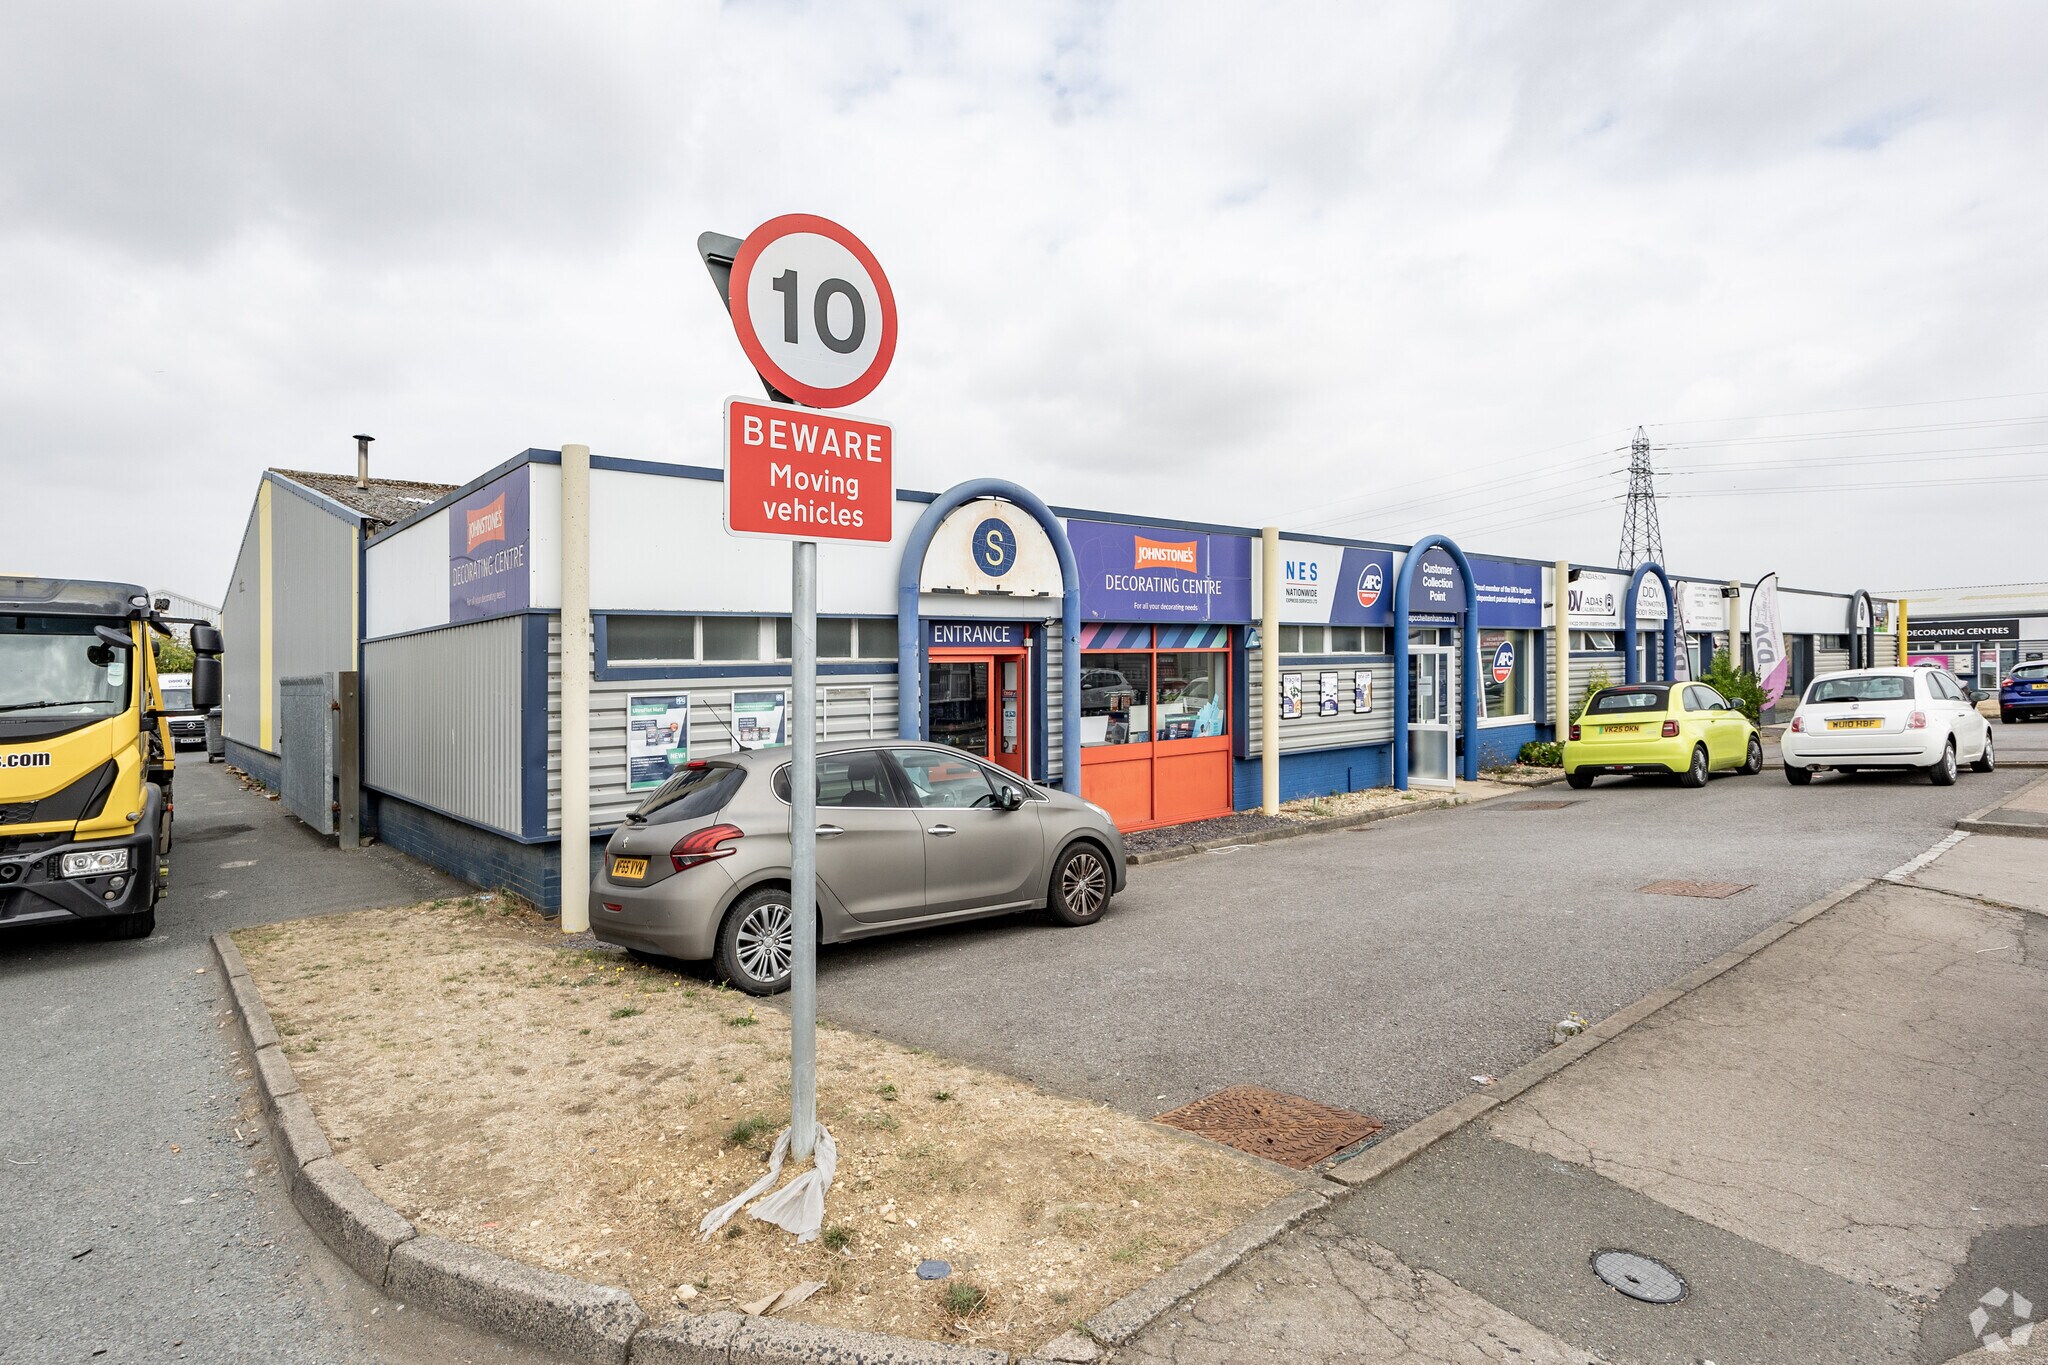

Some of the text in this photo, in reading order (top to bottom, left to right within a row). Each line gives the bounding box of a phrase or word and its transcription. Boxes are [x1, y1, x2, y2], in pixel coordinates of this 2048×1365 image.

[772, 268, 866, 354] 10
[743, 414, 883, 463] BEWARE
[770, 462, 859, 500] Moving
[763, 497, 864, 528] vehicles
[985, 529, 1004, 566] S
[1137, 545, 1194, 563] JOHNSTONE'S
[453, 544, 524, 586] DECORATING CENTRE
[1286, 560, 1318, 582] NES
[1422, 562, 1453, 575] Customer
[1105, 574, 1222, 595] DECORATING CENTRE
[1362, 574, 1381, 590] APC
[1422, 576, 1453, 589] Collection
[1286, 588, 1318, 597] NATIONWIDE
[1429, 590, 1447, 602] Point
[1642, 586, 1660, 598] DDV
[1160, 603, 1184, 611] decorating
[1585, 597, 1603, 606] ADAS
[934, 625, 1011, 643] ENTRANCE
[1966, 627, 2010, 635] CENTRES
[1497, 652, 1513, 666] APC
[0, 752, 50, 768] .com
